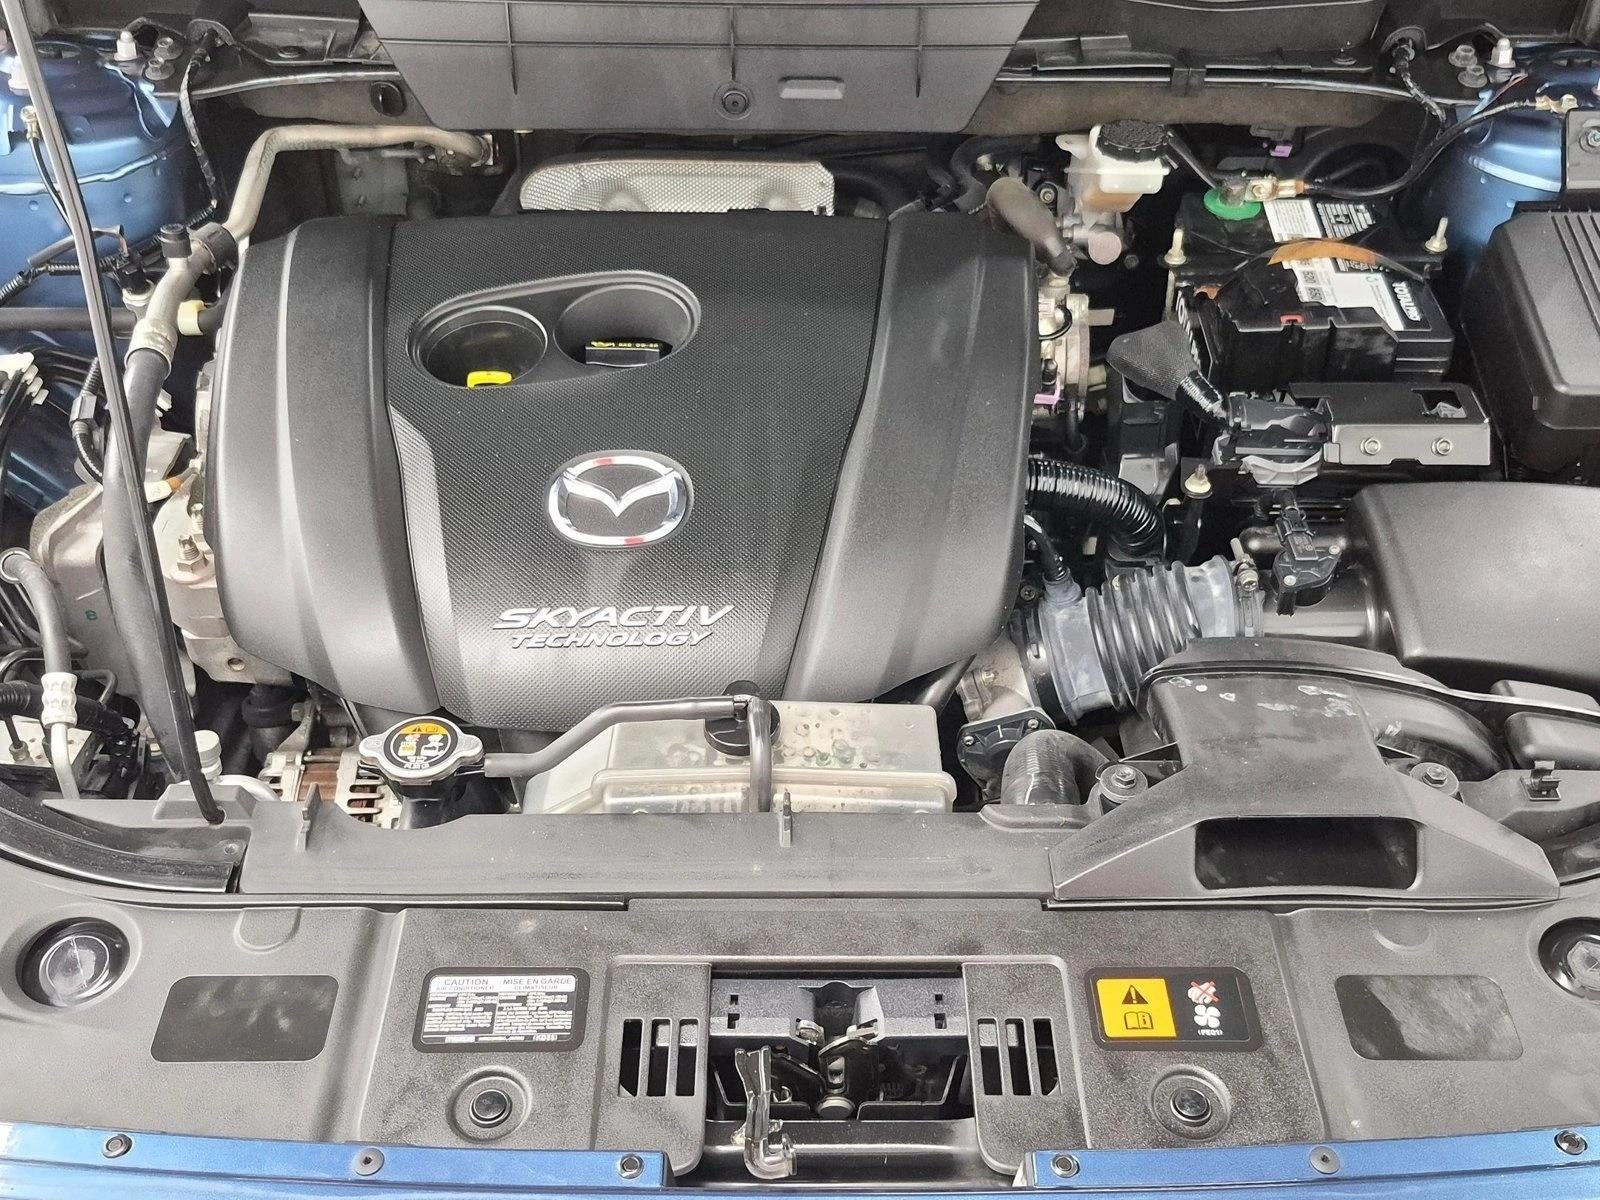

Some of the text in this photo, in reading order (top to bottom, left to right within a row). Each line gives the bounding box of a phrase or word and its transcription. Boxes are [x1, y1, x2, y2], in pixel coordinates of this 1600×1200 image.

[493, 604, 735, 630] SKYACTIV
[512, 630, 713, 649] TECHNOLOGY
[444, 978, 489, 986] CAUTION
[502, 977, 572, 985] MISE EN GARDE
